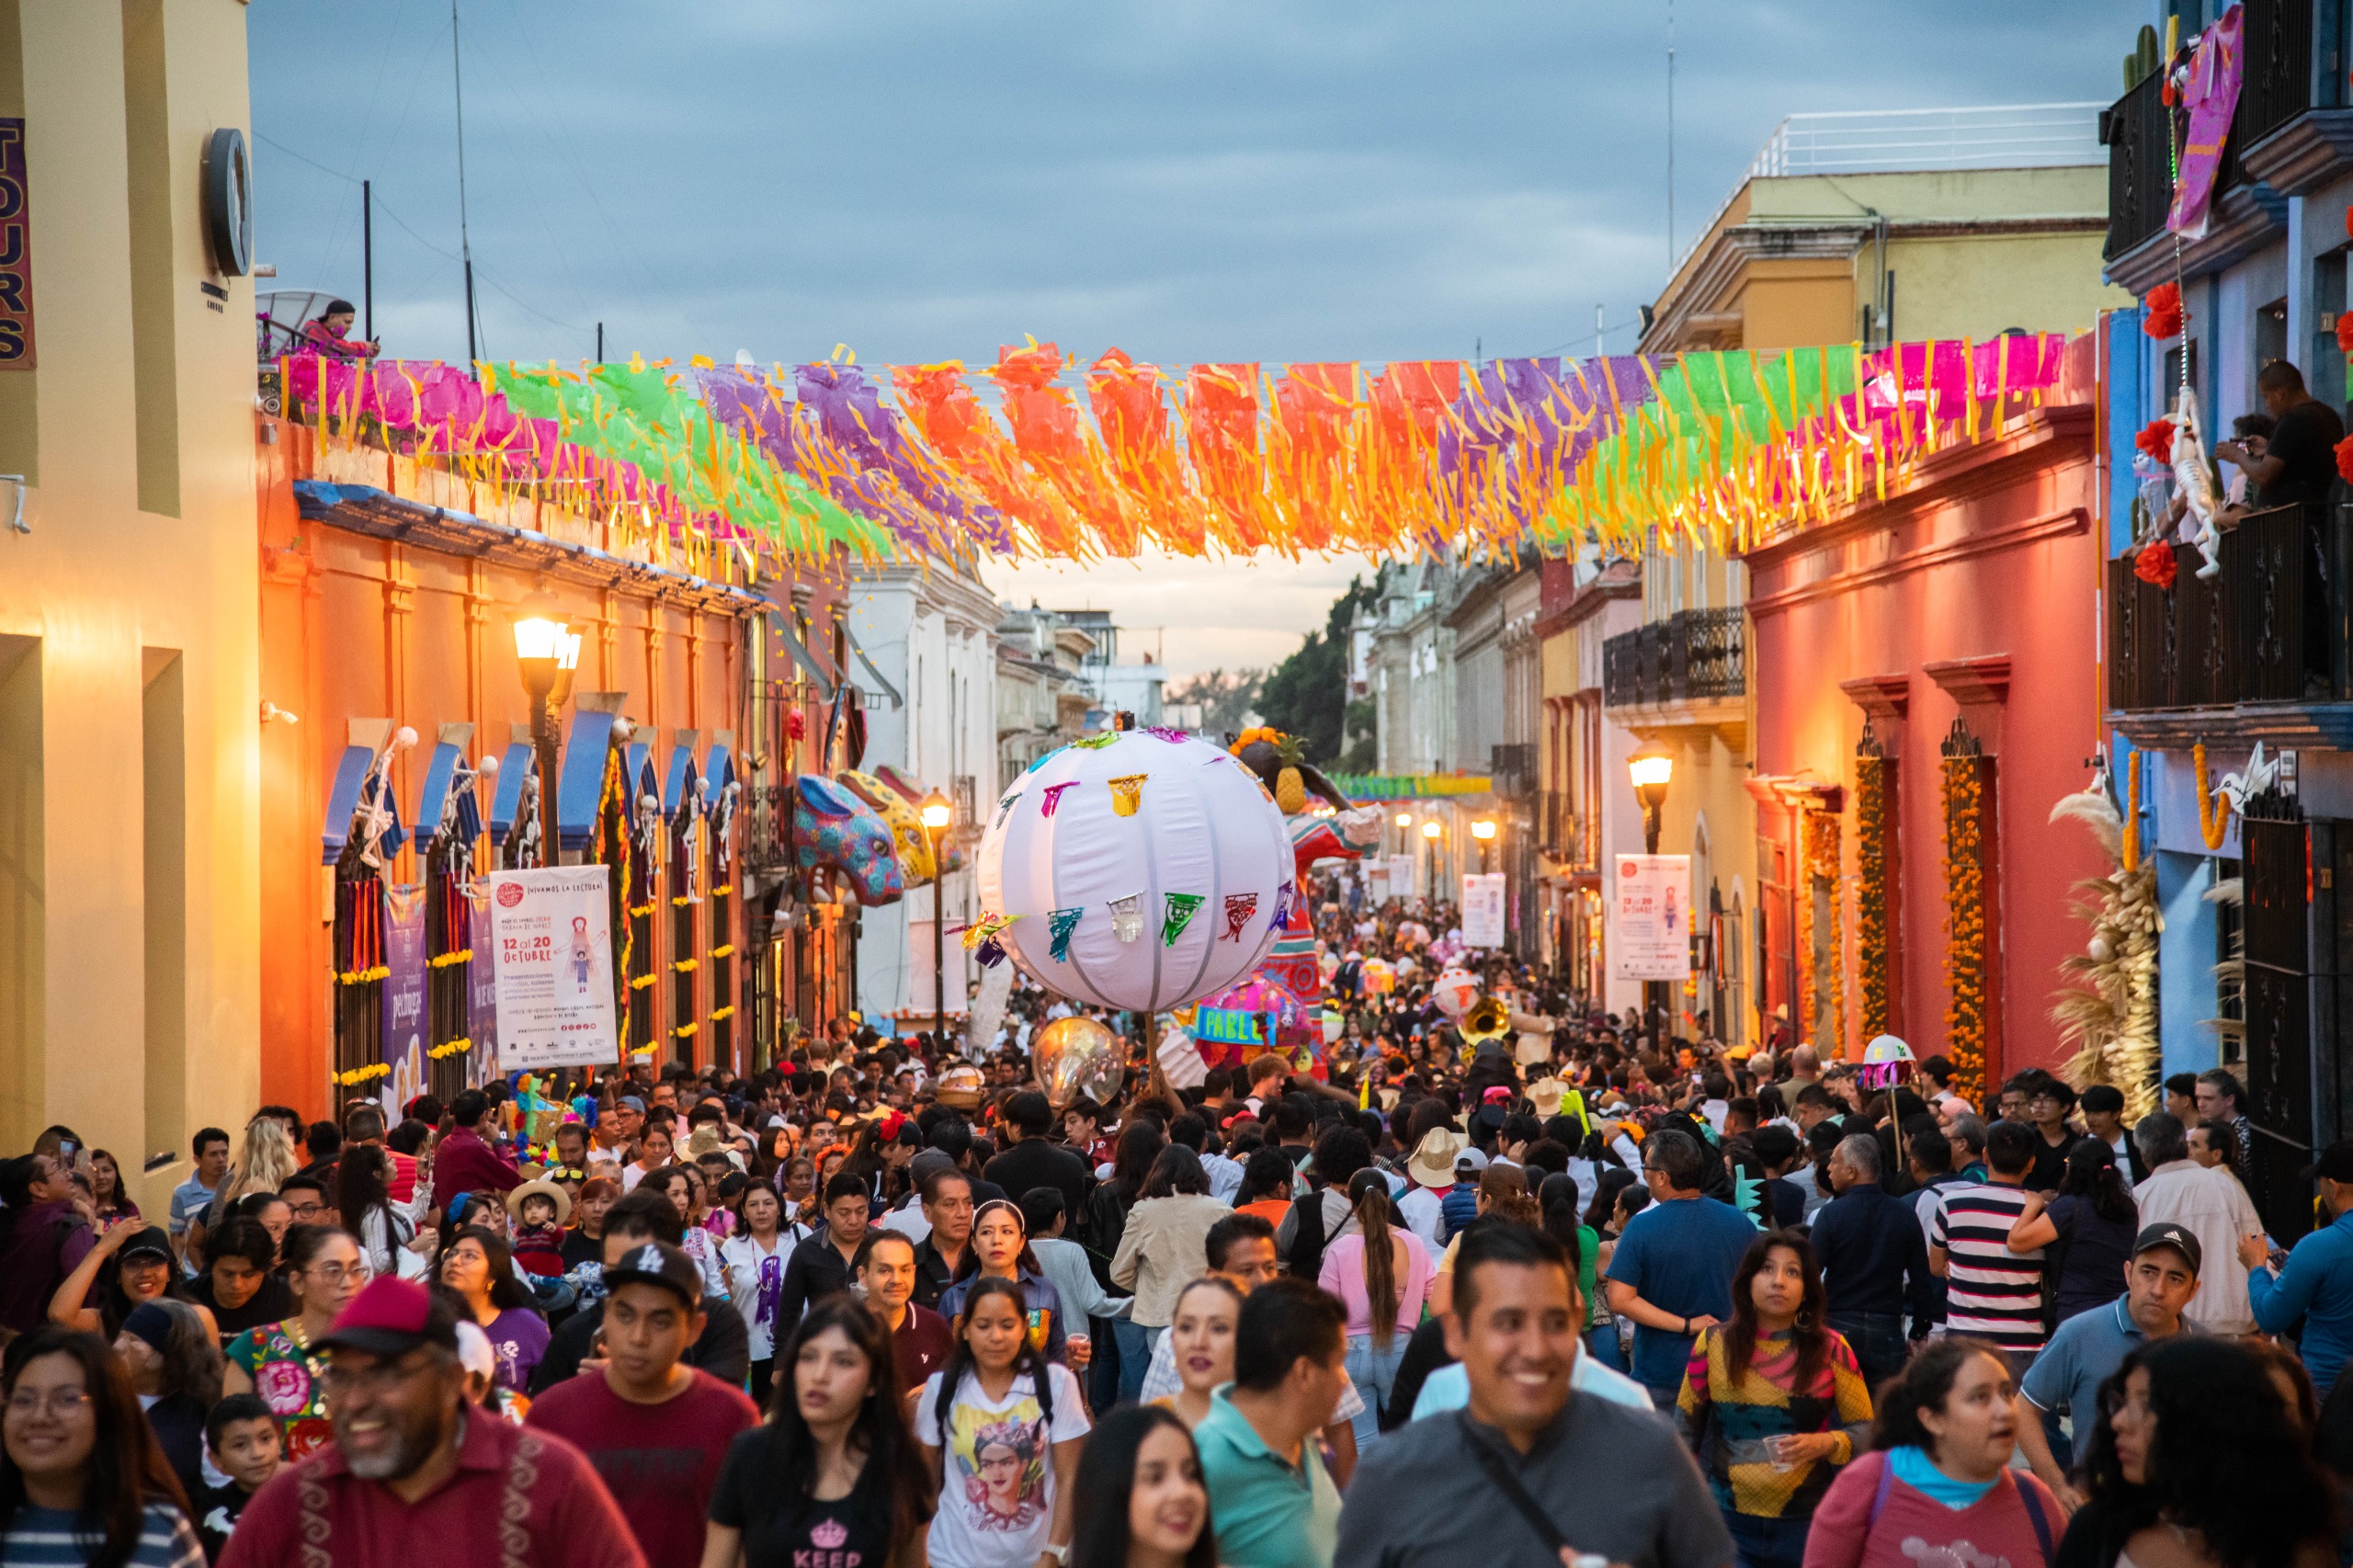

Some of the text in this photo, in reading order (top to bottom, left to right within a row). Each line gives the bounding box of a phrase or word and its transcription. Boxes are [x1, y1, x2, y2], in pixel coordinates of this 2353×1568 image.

[503, 936, 551, 949] 12 al 20
[504, 949, 551, 964] OCTUBRE
[793, 1549, 862, 1568] KEEP
